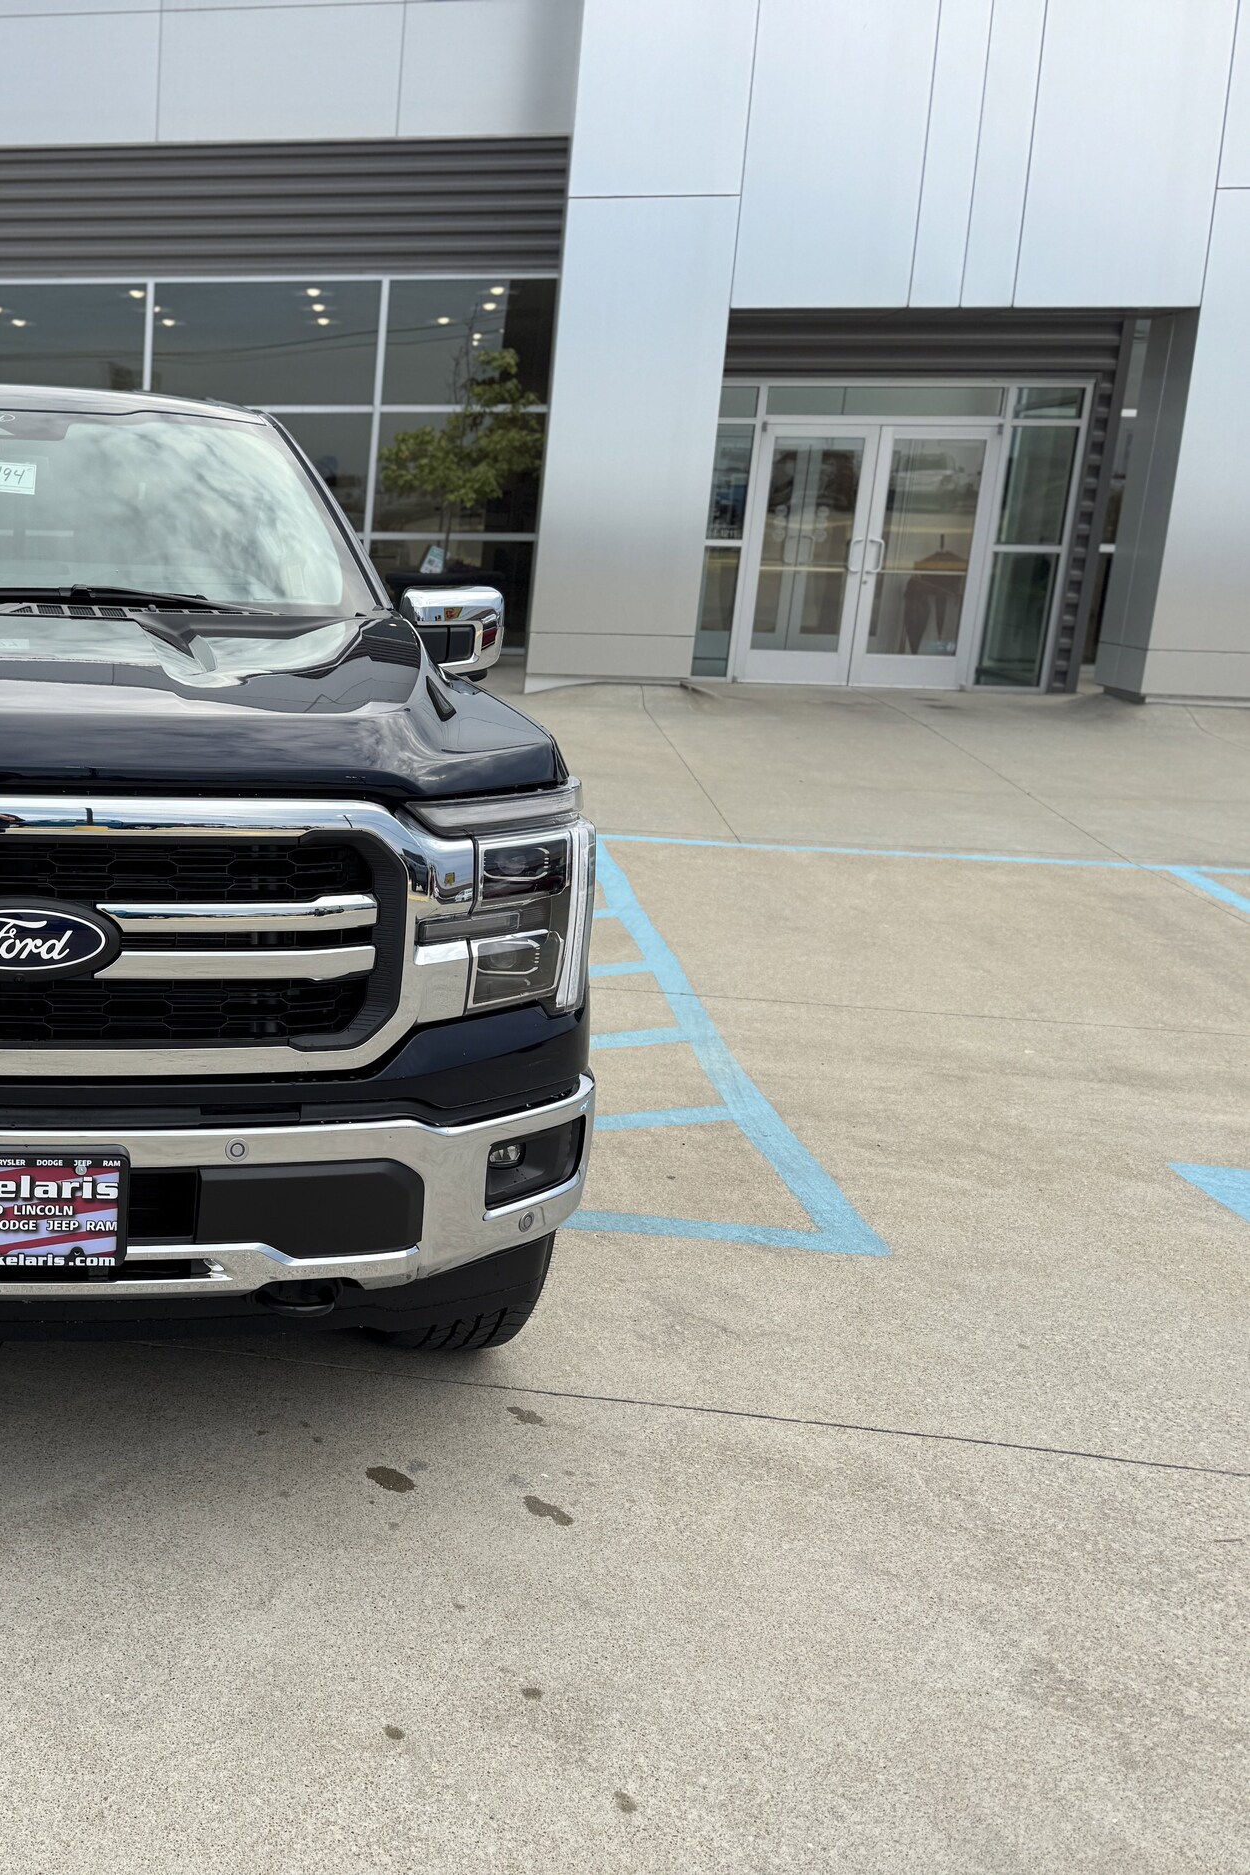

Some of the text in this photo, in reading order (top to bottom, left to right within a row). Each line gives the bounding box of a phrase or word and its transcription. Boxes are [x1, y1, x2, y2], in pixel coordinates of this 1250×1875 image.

[36, 1159, 64, 1167] DODGE
[73, 1159, 92, 1167] JEEP
[102, 1160, 121, 1168] RAM
[13, 1205, 74, 1216] LINCOLN
[46, 1220, 79, 1232] JEEP
[86, 1221, 118, 1232] RAM
